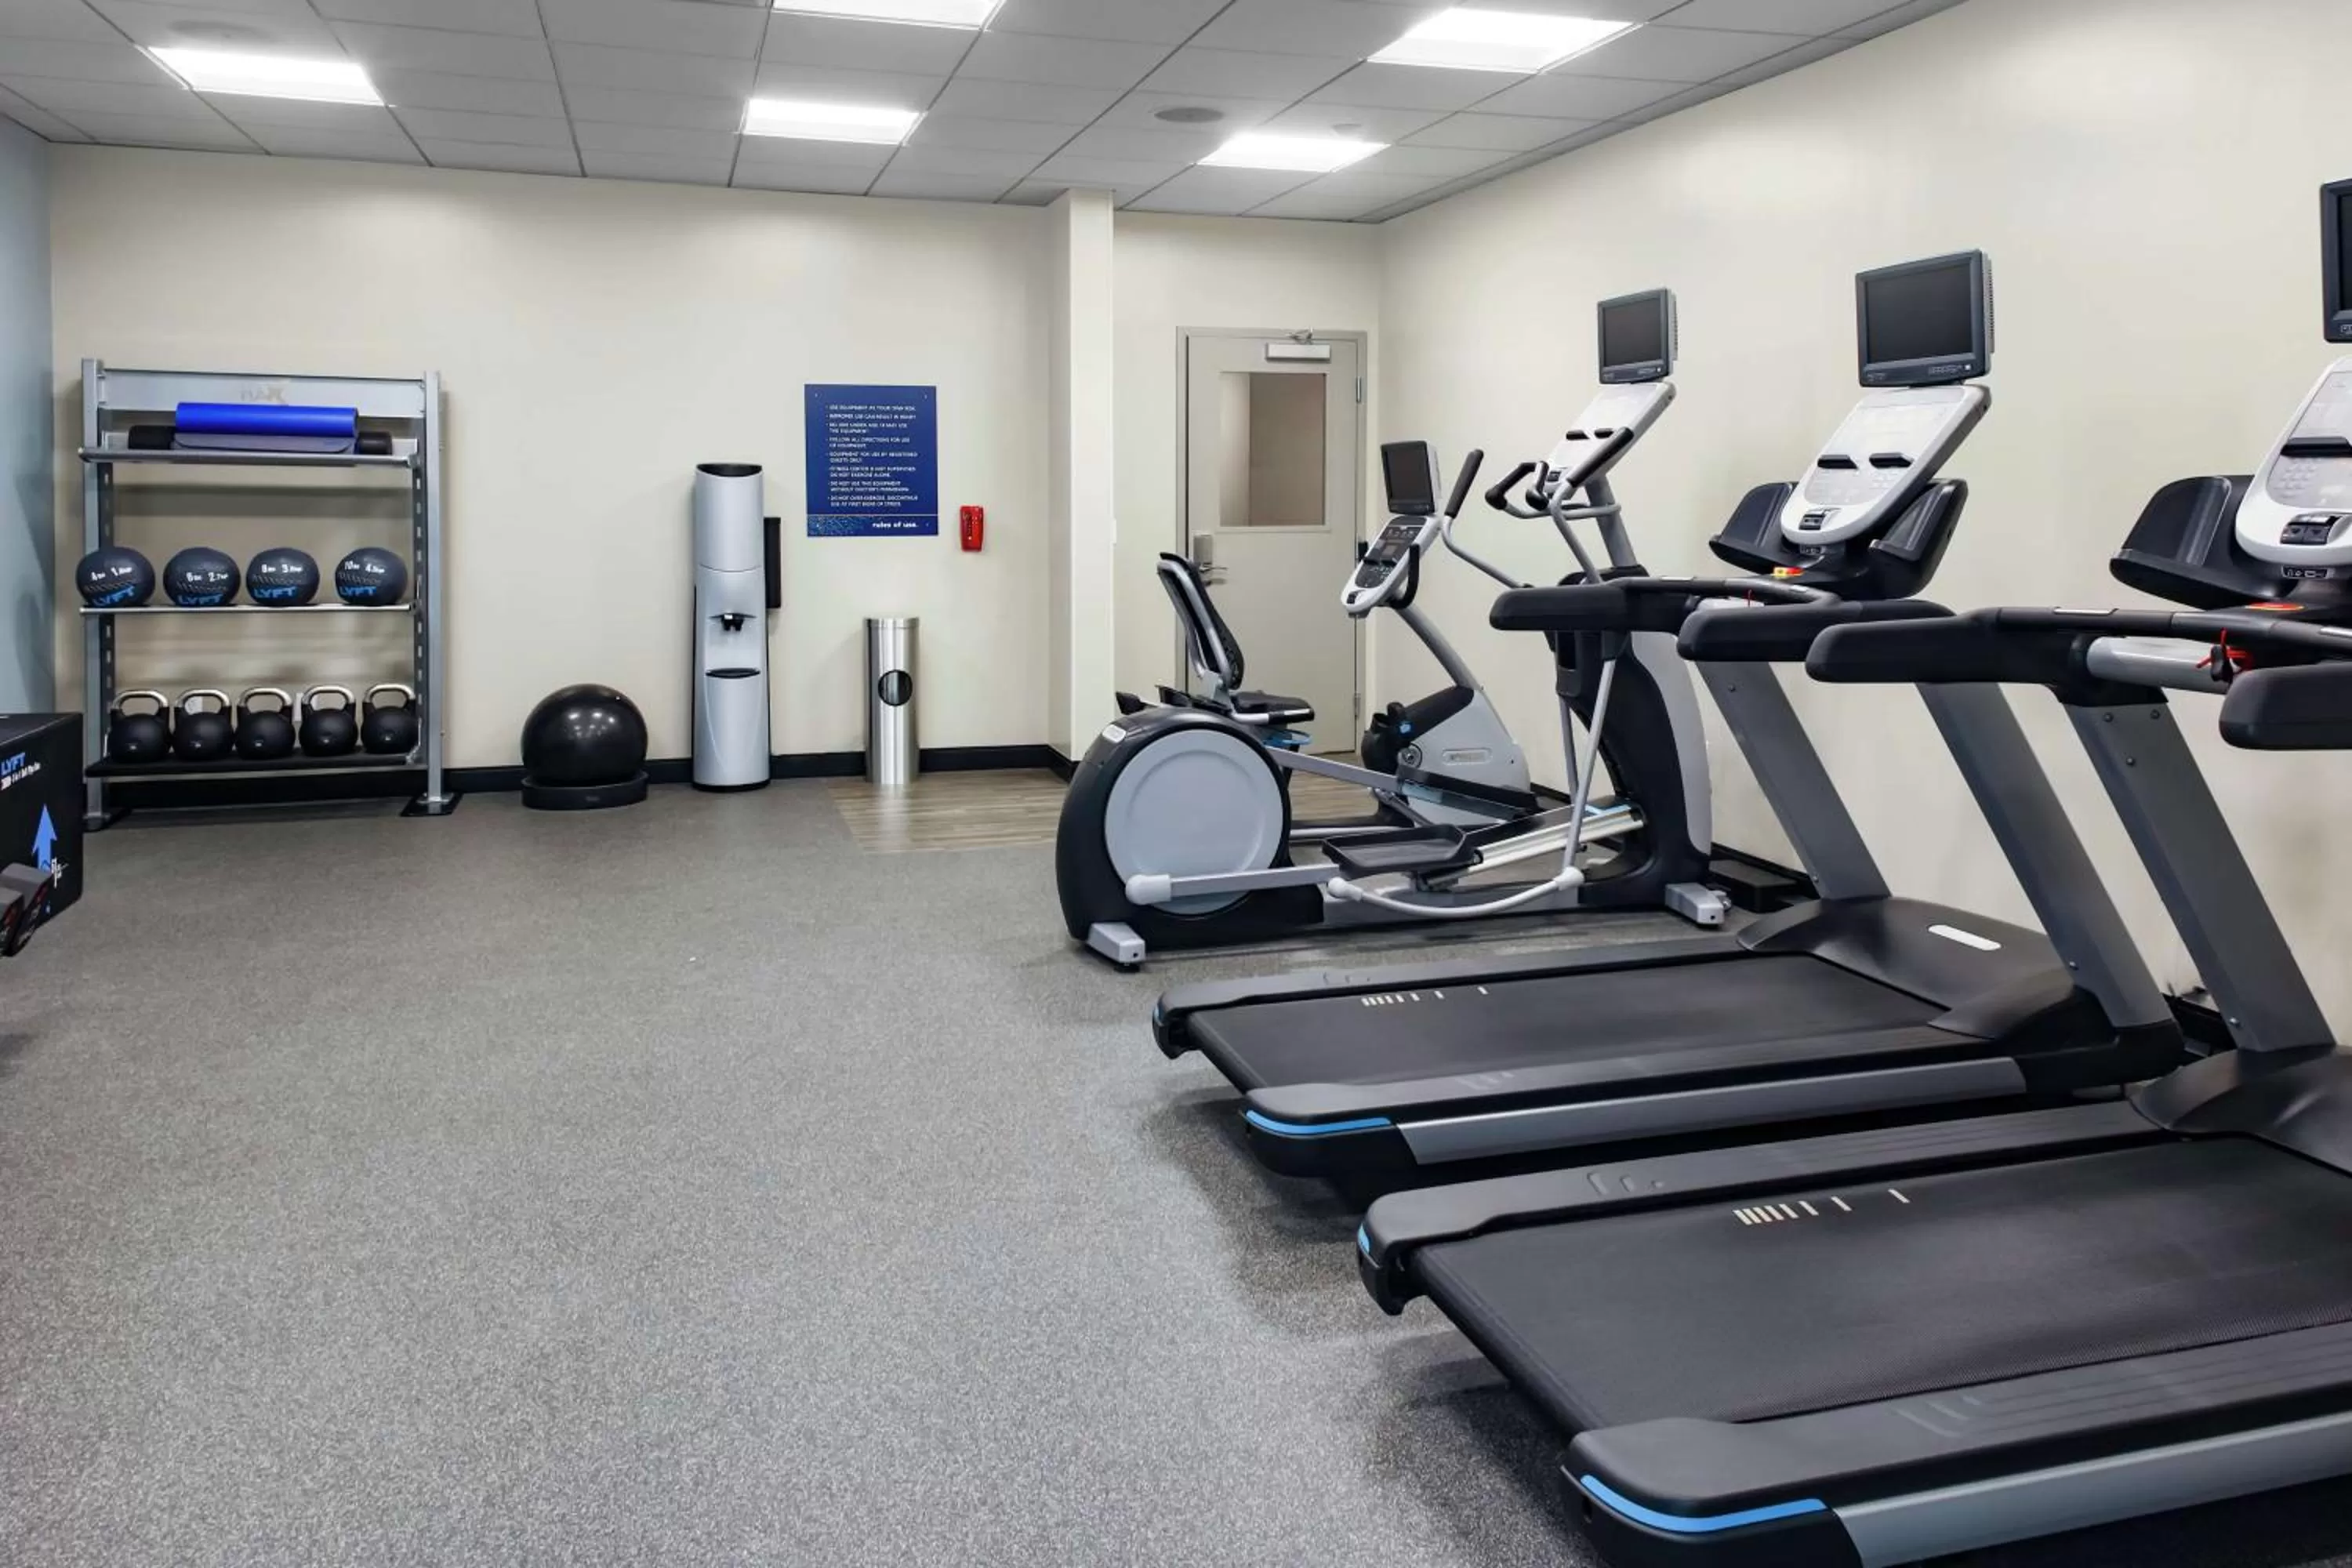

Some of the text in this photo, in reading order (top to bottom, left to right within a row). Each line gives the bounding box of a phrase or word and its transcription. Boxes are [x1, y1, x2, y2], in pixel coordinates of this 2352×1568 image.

[93, 585, 135, 607] LYFT
[254, 586, 296, 599] LYFT
[339, 586, 377, 597] LYFT
[177, 593, 223, 605] LYFT
[1, 752, 26, 776] LYFT
